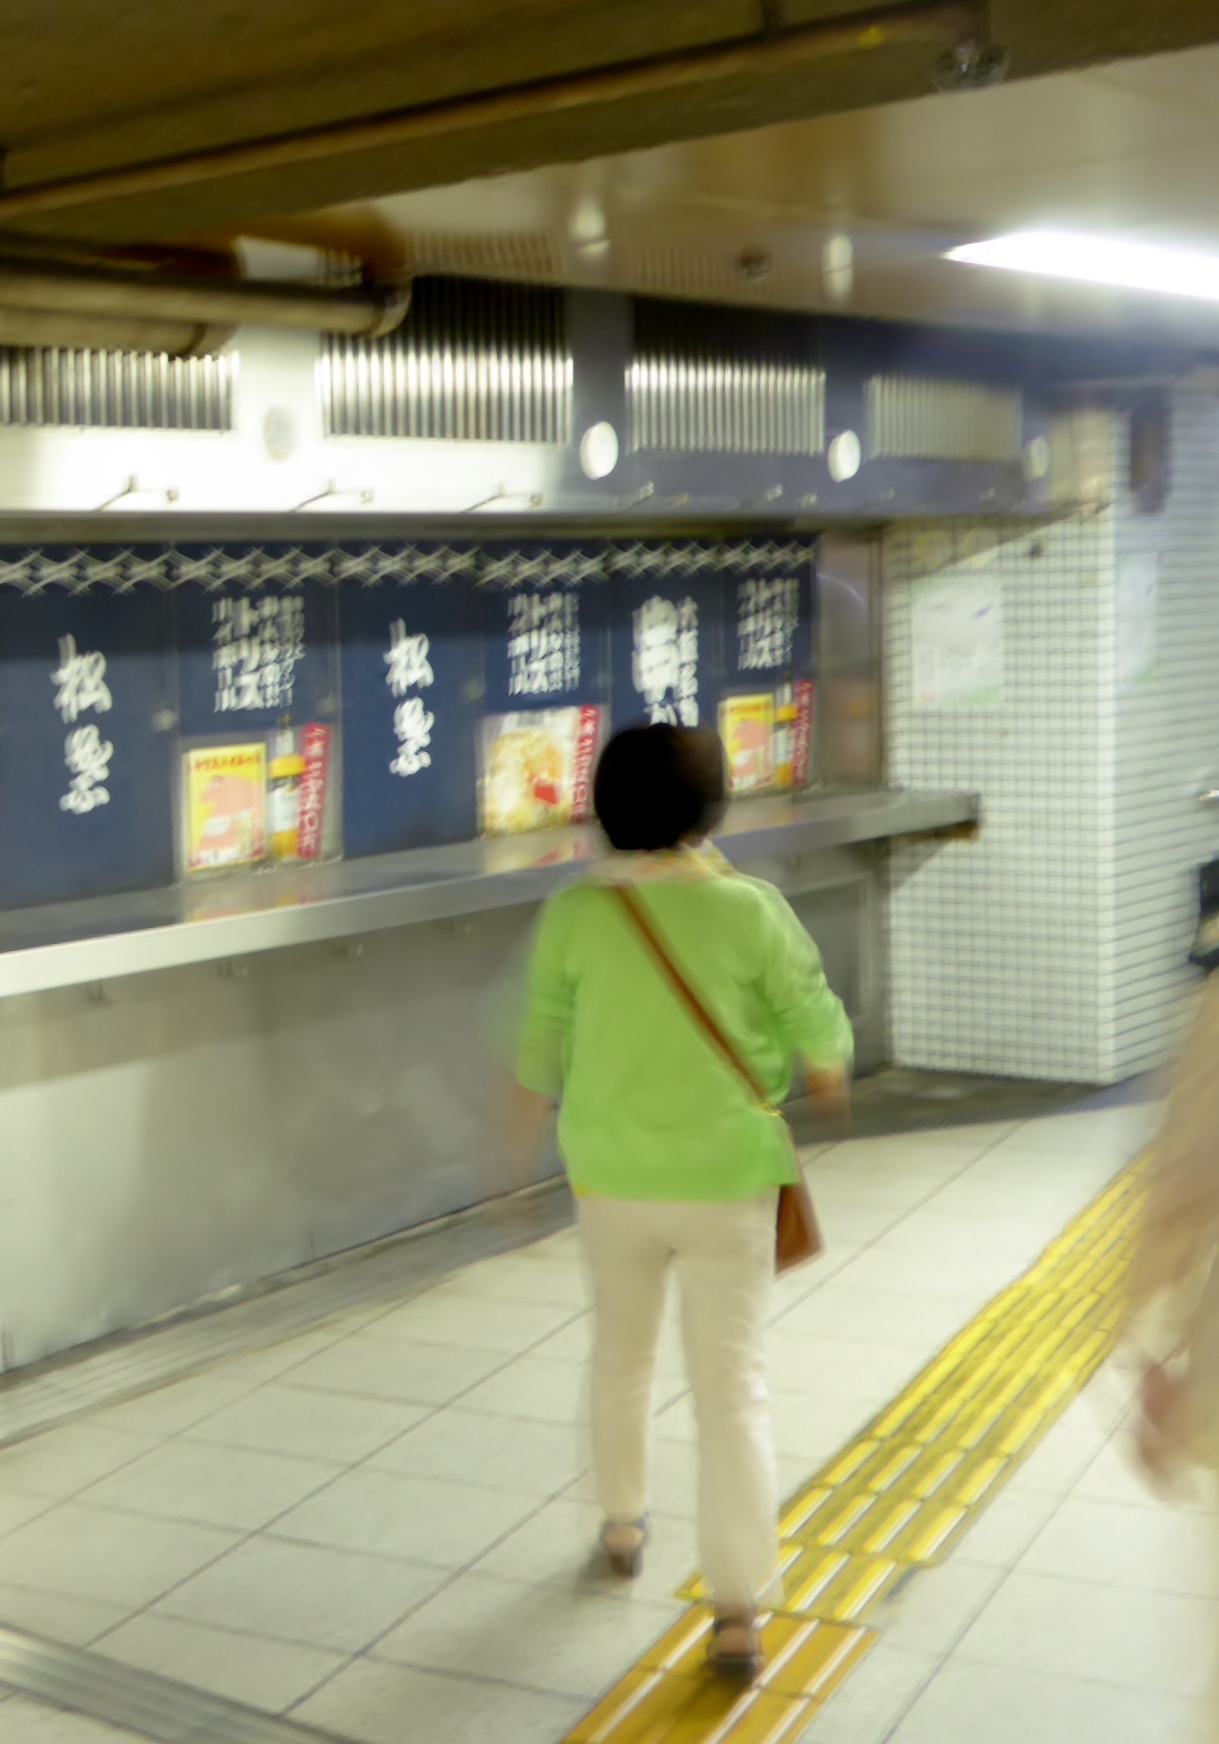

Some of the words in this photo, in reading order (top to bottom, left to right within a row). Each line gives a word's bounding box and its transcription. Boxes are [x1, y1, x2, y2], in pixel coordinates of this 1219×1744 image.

[211, 597, 237, 713] ハイボール
[233, 596, 263, 711] トリス
